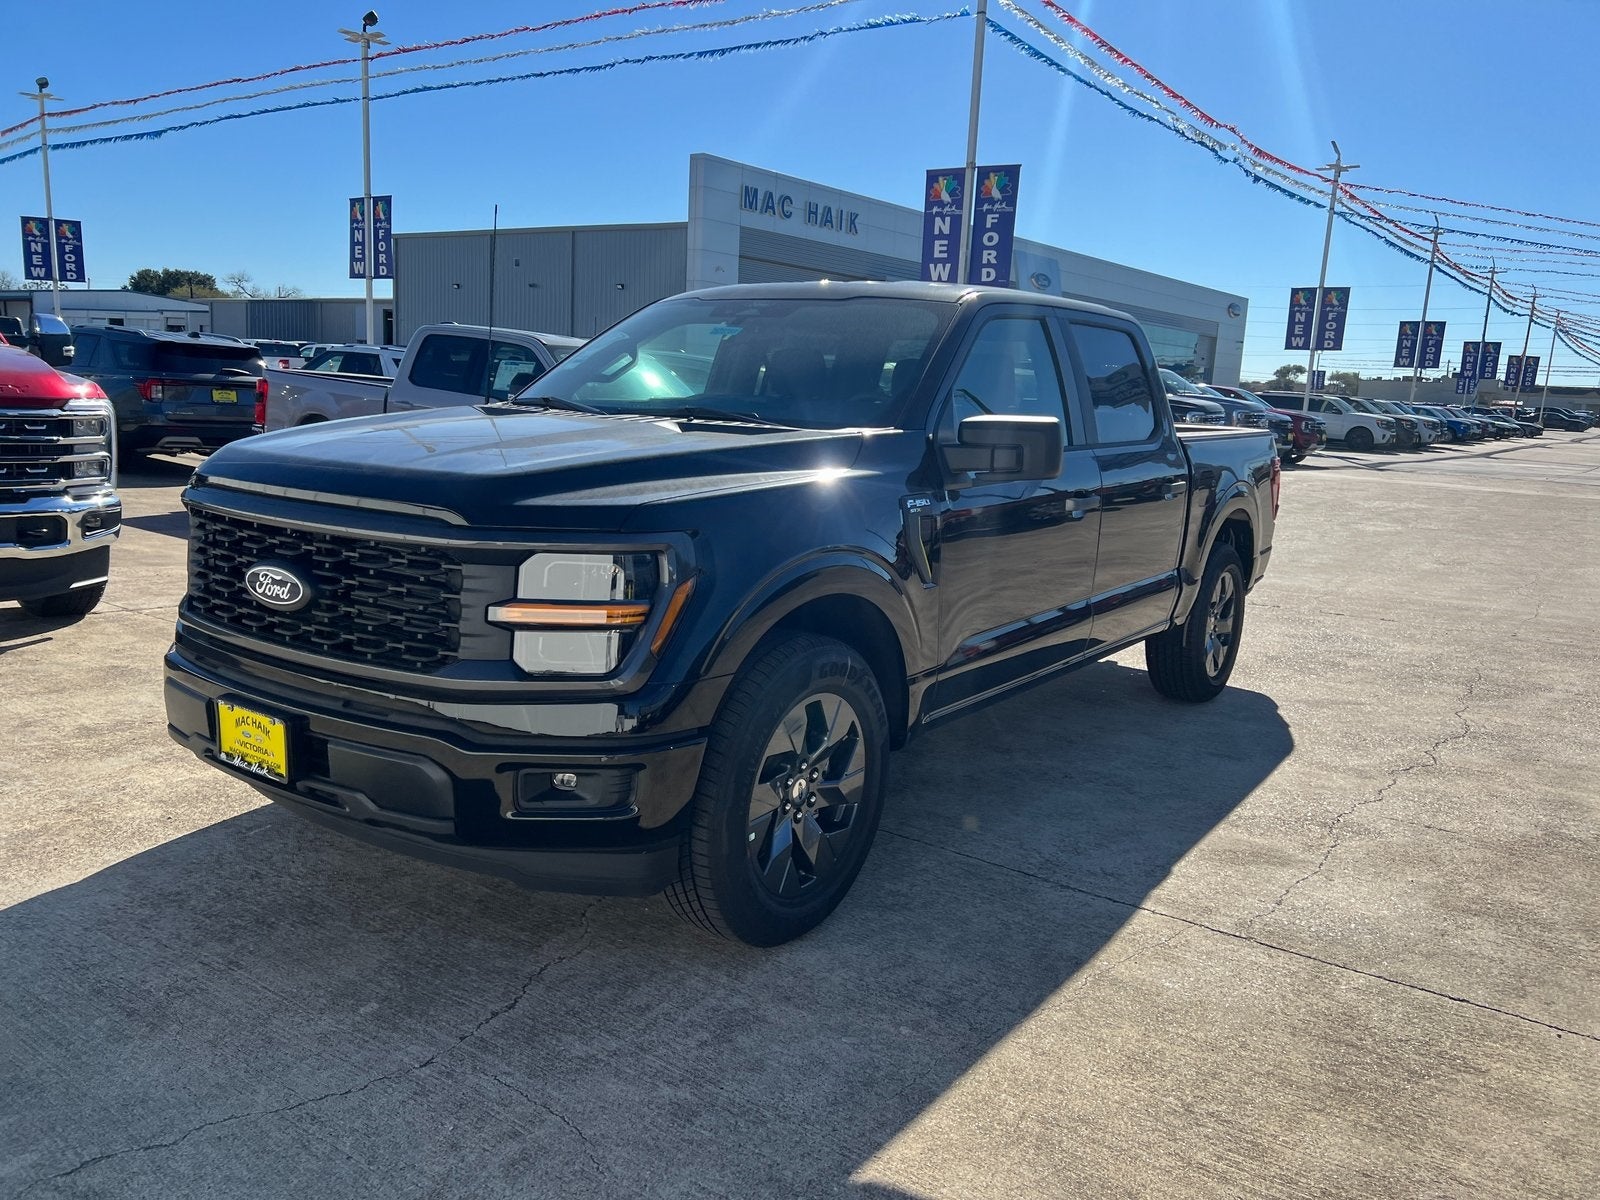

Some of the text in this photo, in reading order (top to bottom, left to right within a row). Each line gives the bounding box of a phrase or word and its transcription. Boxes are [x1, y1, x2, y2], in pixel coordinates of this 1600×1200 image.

[741, 184, 860, 236] MAC HAIK
[30, 241, 46, 278] NEW
[64, 244, 78, 280] FORD
[353, 229, 365, 275] NEW
[378, 229, 388, 276] FORD
[929, 216, 952, 282] NEW
[981, 214, 1000, 282] FORD
[1291, 312, 1306, 347] NEW
[1323, 312, 1338, 349] FORD
[1399, 339, 1412, 366] NEW
[1424, 340, 1436, 367] FORD
[1463, 355, 1474, 377] NEW
[1484, 356, 1494, 378] FORD
[1507, 367, 1516, 385] NEW
[1524, 368, 1534, 386] FORD
[255, 571, 291, 600] Ford
[235, 715, 271, 740] MAC HAIK
[239, 739, 271, 757] VICTORIA
[232, 754, 269, 775] Mac Haik
